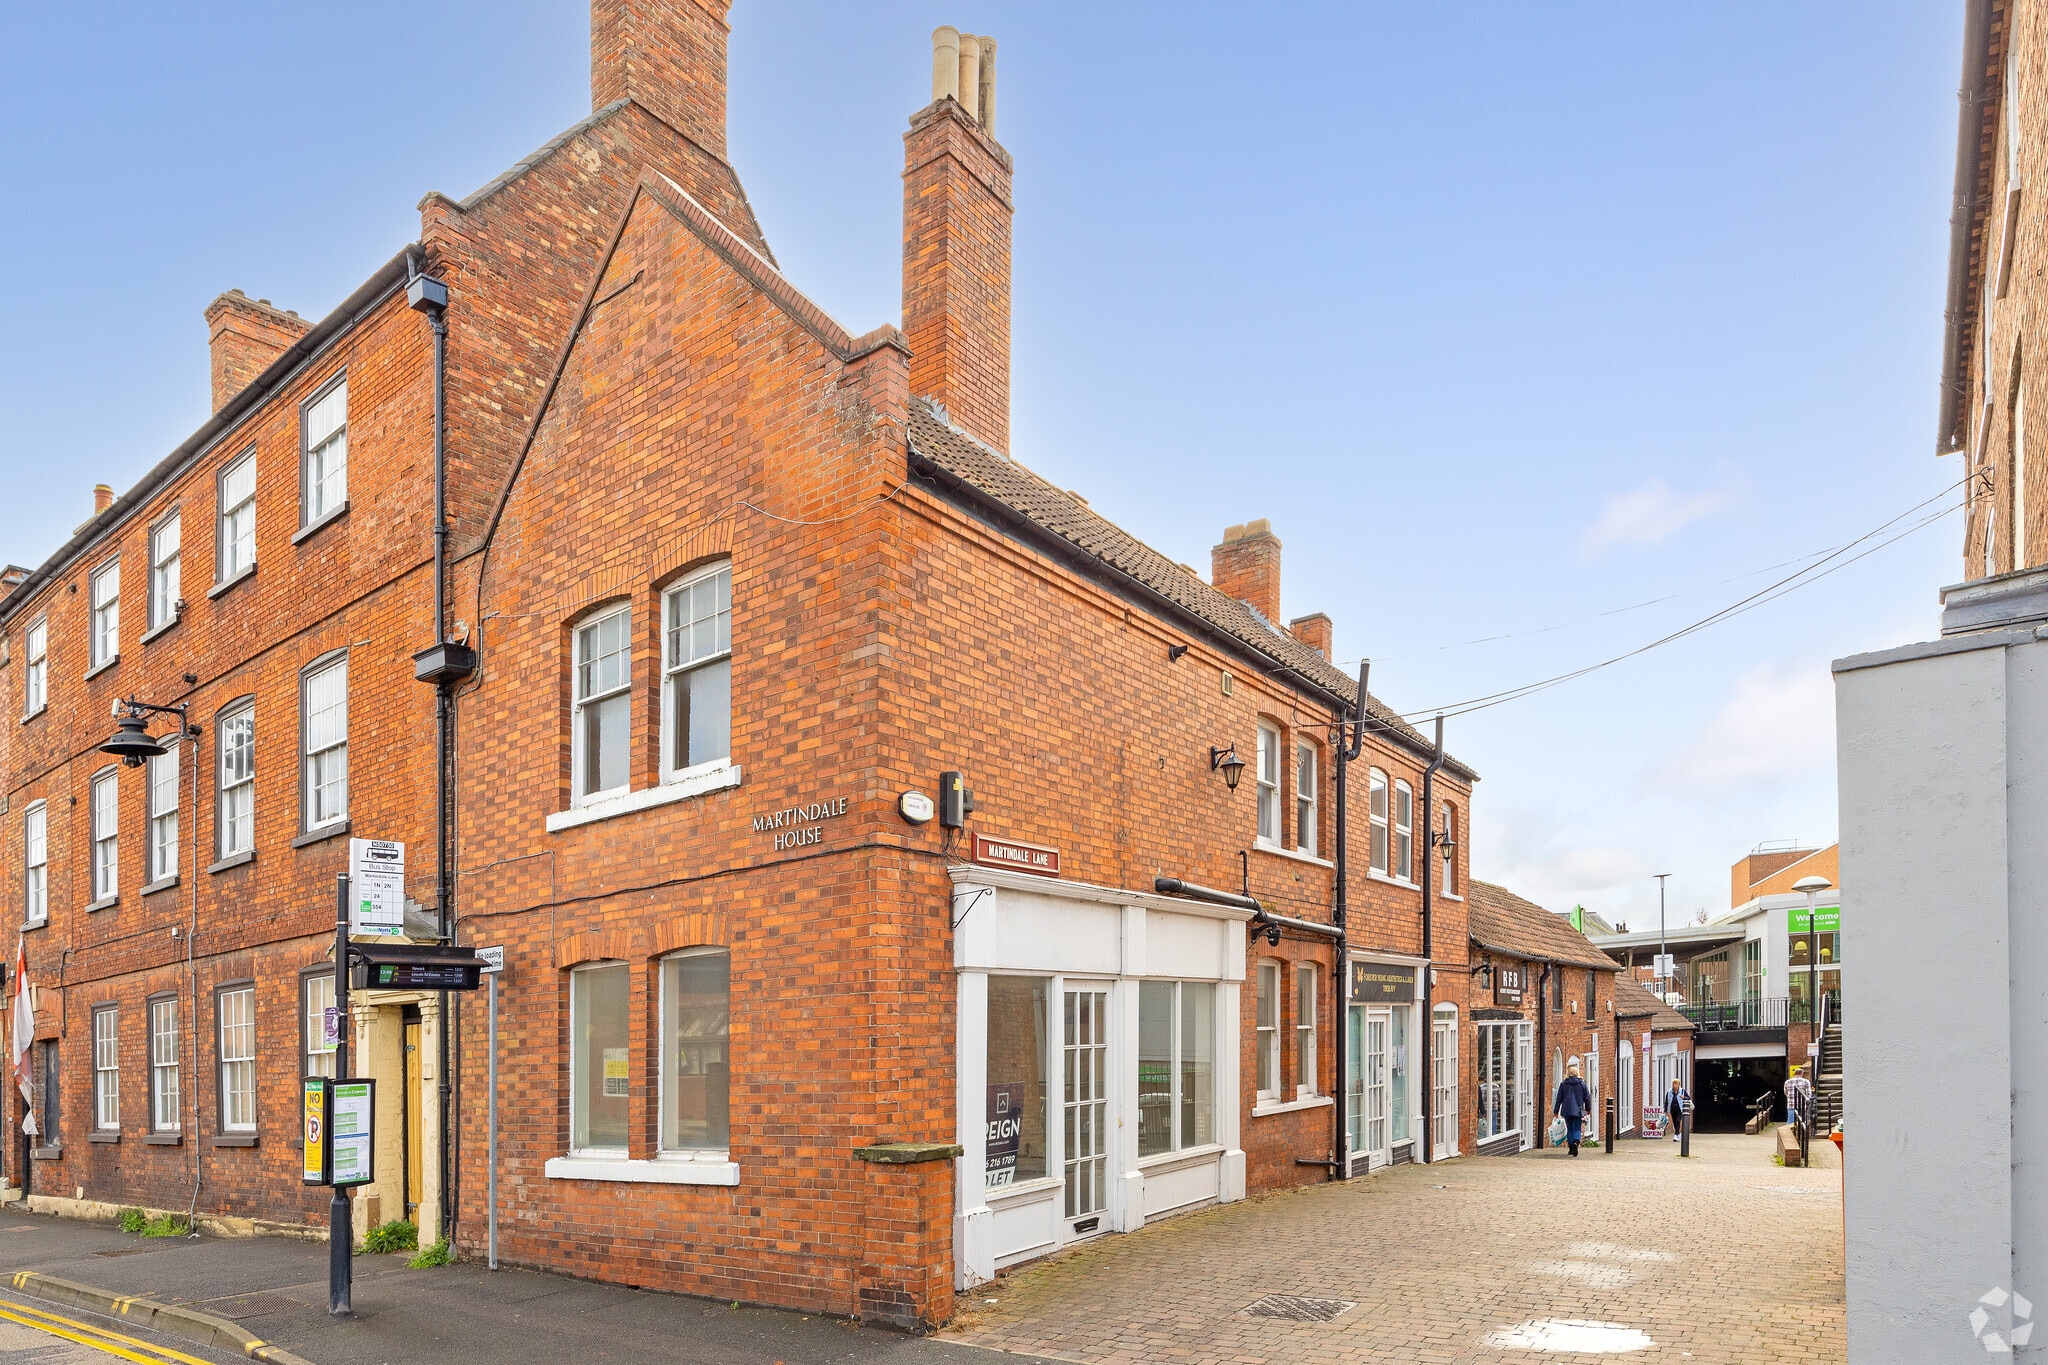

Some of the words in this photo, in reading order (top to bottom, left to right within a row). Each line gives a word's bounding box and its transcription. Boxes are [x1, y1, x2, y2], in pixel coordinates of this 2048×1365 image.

[752, 797, 847, 832] MARTINDALE
[774, 826, 822, 850] HOUSE
[988, 844, 1028, 862] MARTINDALE
[1032, 852, 1048, 866] LANE
[1796, 913, 1839, 922] Wecome
[485, 950, 501, 959] loading
[1503, 970, 1518, 988] RFB
[310, 1093, 320, 1104] NO
[990, 1158, 1000, 1168] 216
[1002, 1155, 1015, 1166] 1789
[991, 1170, 1011, 1186] LET
